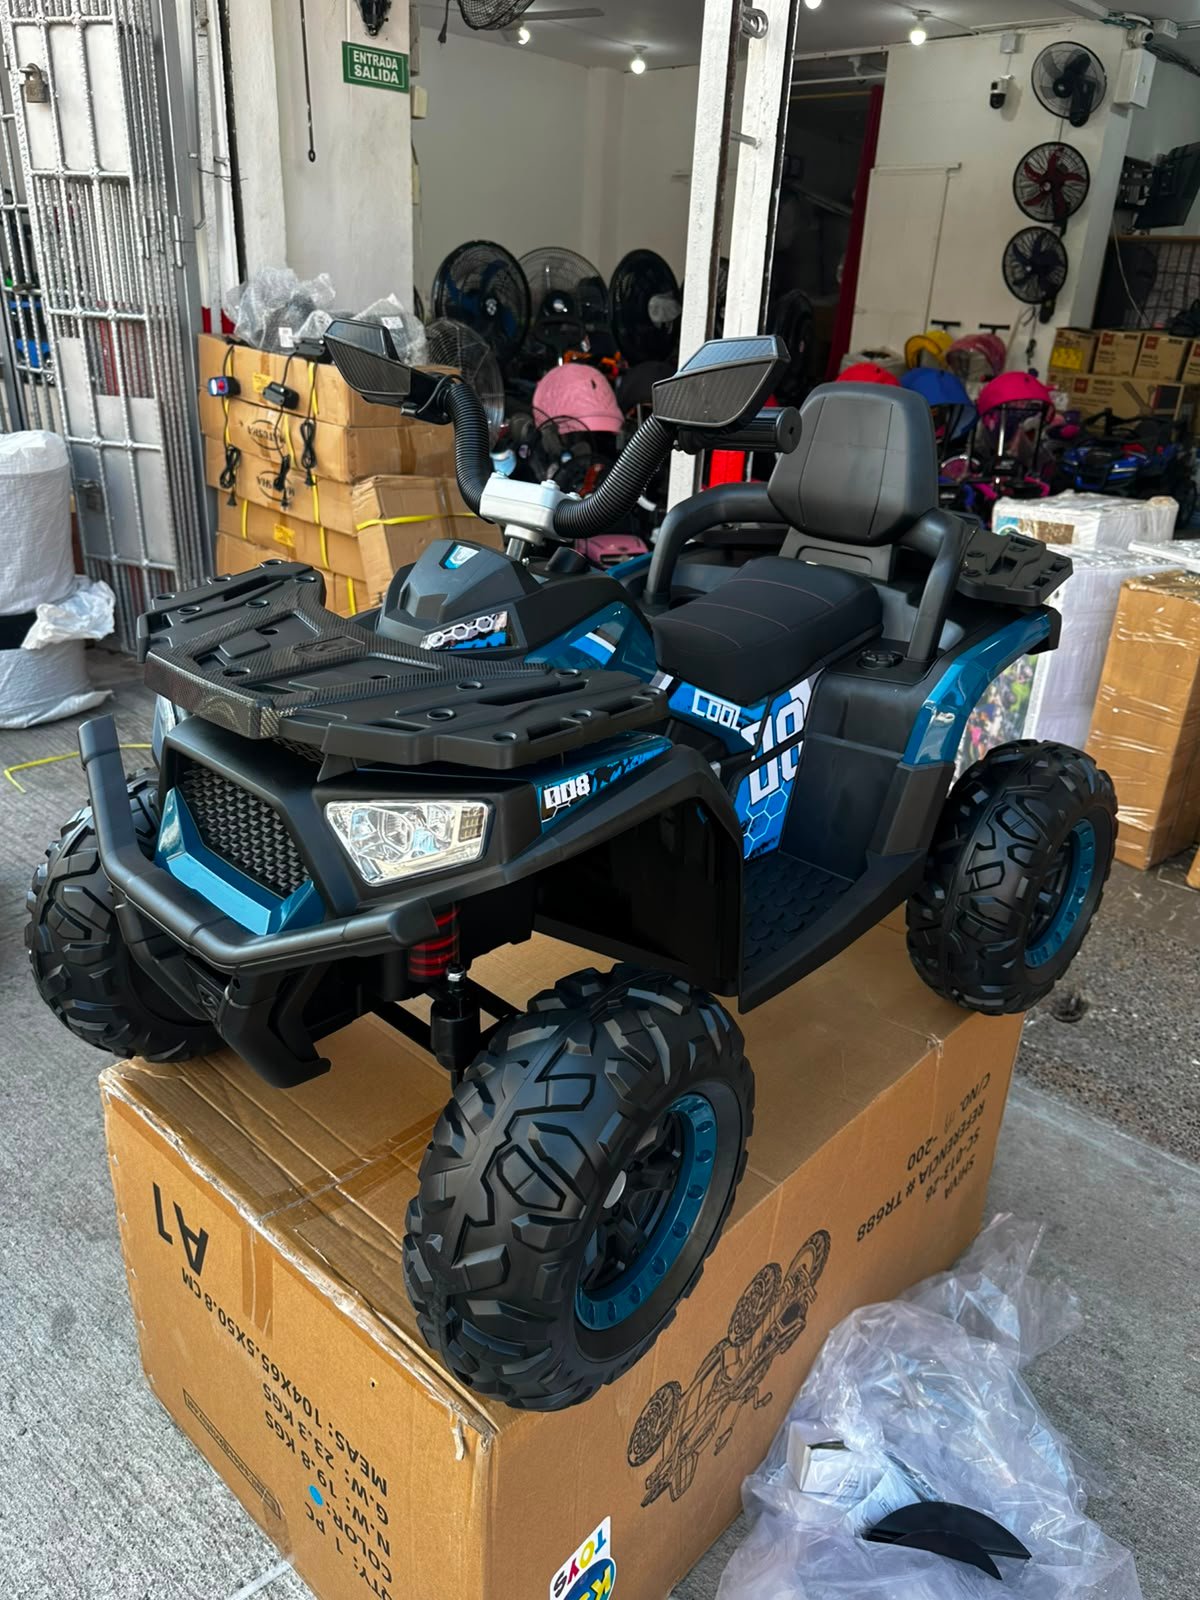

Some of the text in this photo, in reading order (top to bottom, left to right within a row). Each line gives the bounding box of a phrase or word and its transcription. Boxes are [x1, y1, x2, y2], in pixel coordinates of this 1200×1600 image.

[353, 50, 399, 70] ENTRADA
[354, 64, 399, 84] SALIDA
[691, 688, 742, 731] COOL
[543, 773, 591, 810] 008
[856, 1099, 985, 1243] REFERENCIA # TR688
[153, 1181, 209, 1277] A1
[181, 1266, 202, 1299] CM
[204, 1292, 322, 1429] 104X65.5X50.8
[262, 1383, 389, 1525] G.W: 23.3 KGS
[265, 1410, 390, 1558] N.W: 19.8 KGS
[328, 1422, 387, 1497] MEAS:
[304, 1501, 326, 1536] PC
[326, 1501, 392, 1583] COLOR:
[335, 1536, 344, 1555] 1
[553, 1527, 607, 1598] TOYS
